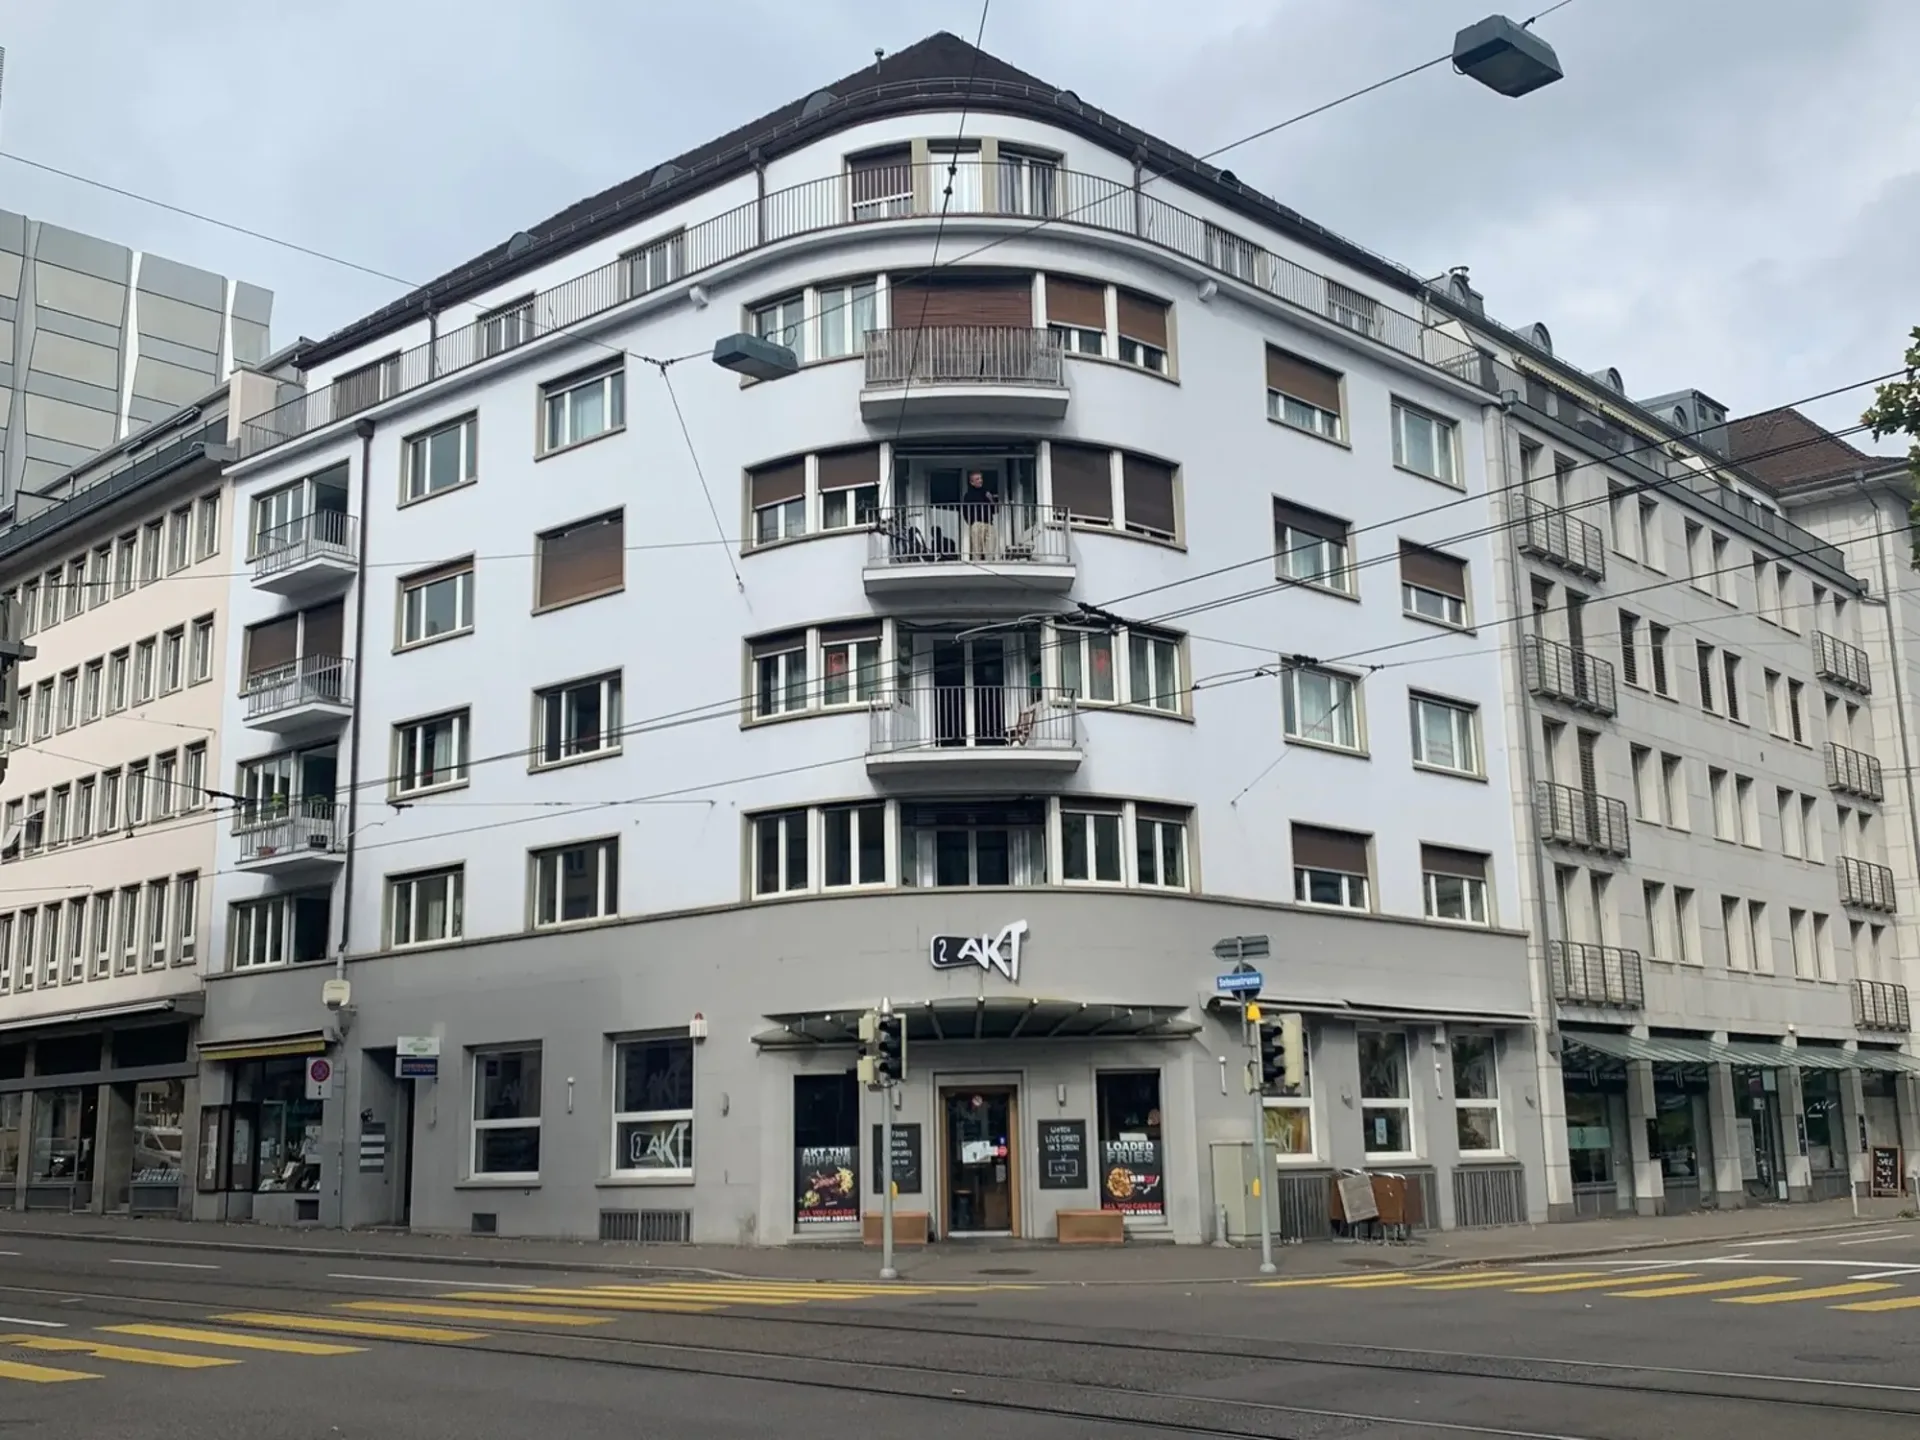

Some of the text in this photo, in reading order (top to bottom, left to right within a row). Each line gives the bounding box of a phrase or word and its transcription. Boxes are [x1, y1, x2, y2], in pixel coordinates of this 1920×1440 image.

[938, 919, 1028, 981] 2 AKT
[646, 1121, 690, 1169] AKT
[1106, 1141, 1154, 1152] LOADED
[803, 1147, 851, 1157] AKT THE
[1107, 1151, 1154, 1164] FRIES
